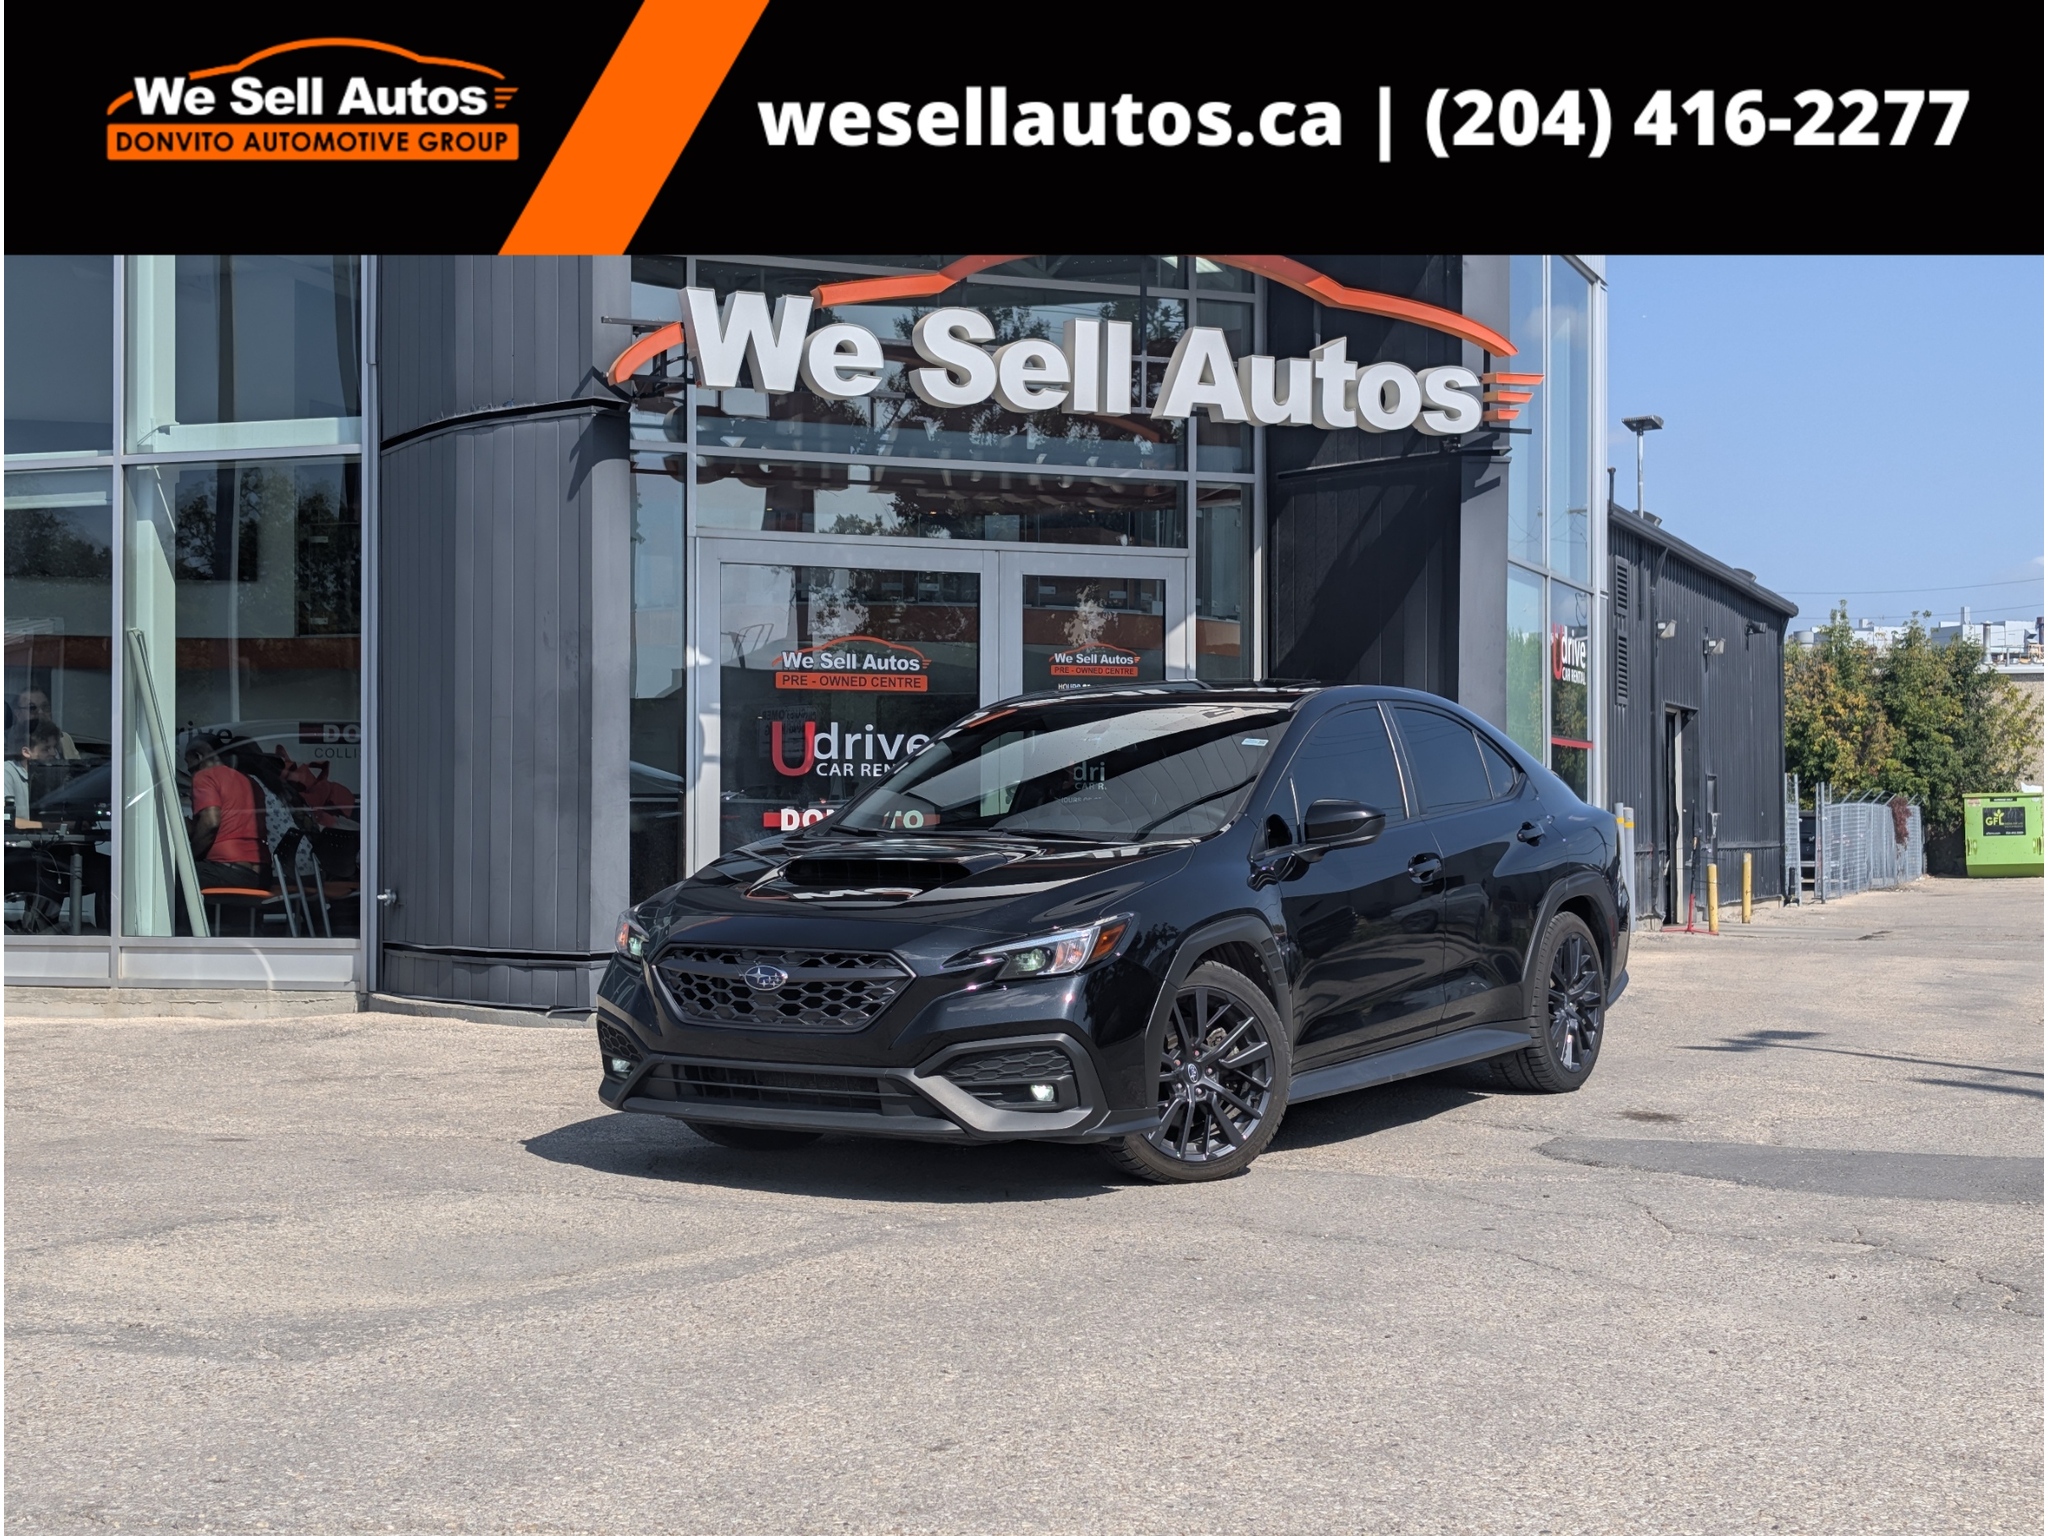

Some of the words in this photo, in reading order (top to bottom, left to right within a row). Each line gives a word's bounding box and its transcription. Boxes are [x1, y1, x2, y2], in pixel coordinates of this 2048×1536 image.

[678, 287, 885, 400] We
[908, 306, 1133, 415] Sell
[1151, 326, 1483, 437] Autos
[1552, 622, 1586, 680] Udrive
[782, 652, 814, 669] We
[820, 653, 857, 670] Sell
[862, 653, 921, 671] Autos
[1054, 653, 1073, 663] We
[1076, 653, 1097, 664] Sell
[1100, 654, 1134, 665] Autos
[1054, 666, 1069, 674] PRE
[1075, 667, 1103, 675] OWNED
[1562, 667, 1571, 681] CAR
[782, 675, 808, 686] PRE
[819, 675, 867, 688] OWNED
[871, 677, 921, 689] CENTRE
[772, 721, 931, 776] Udrive
[816, 763, 854, 777] CAR
[1985, 813, 2004, 826] GFL
